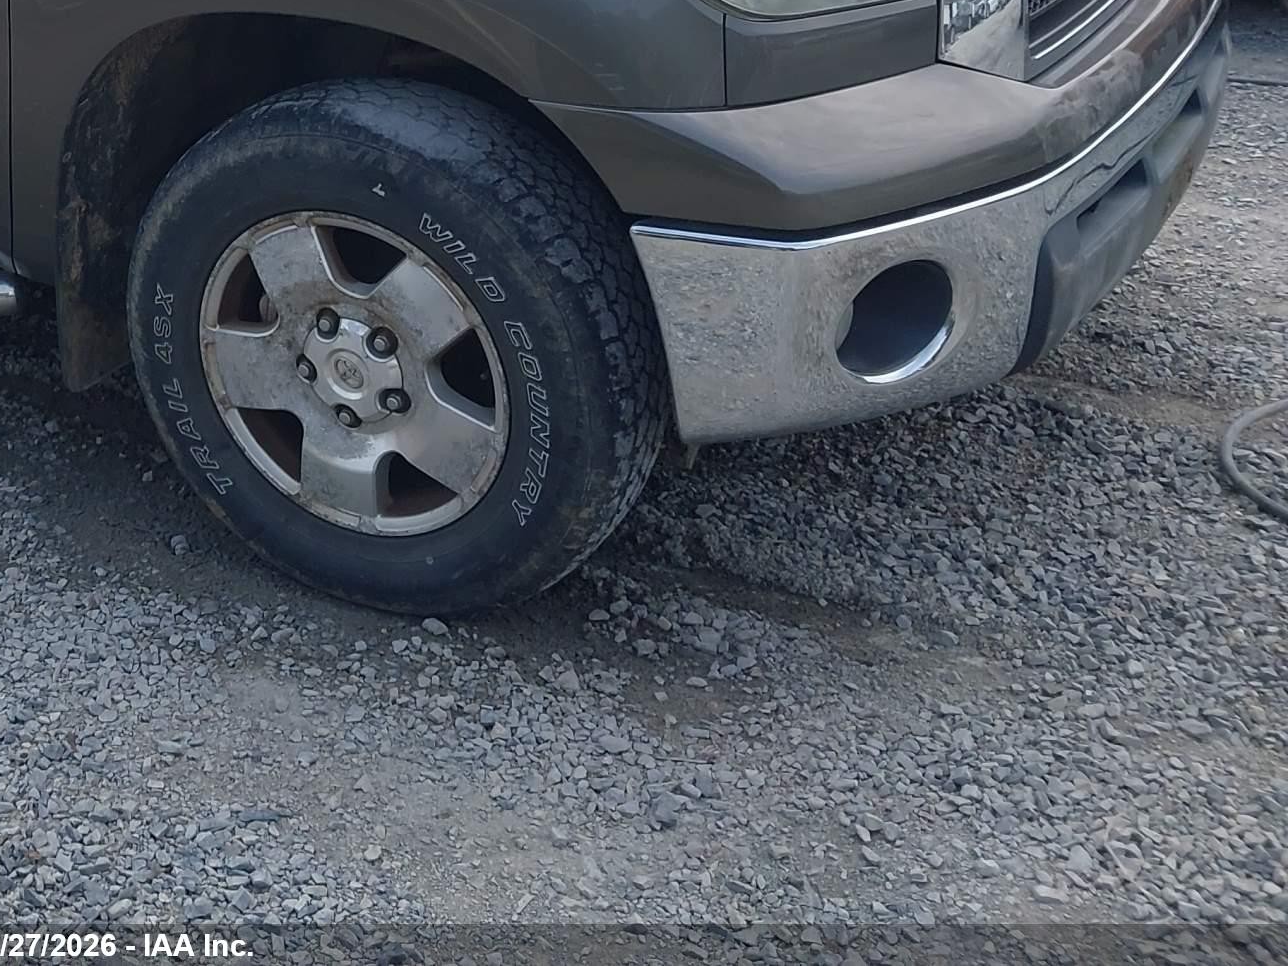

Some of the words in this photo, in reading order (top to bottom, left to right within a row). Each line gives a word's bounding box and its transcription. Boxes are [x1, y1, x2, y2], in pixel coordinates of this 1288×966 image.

[153, 283, 174, 365] 4SX
[418, 212, 506, 303] WILD
[503, 320, 551, 527] COUNTRY
[163, 377, 234, 495] TRAIL
